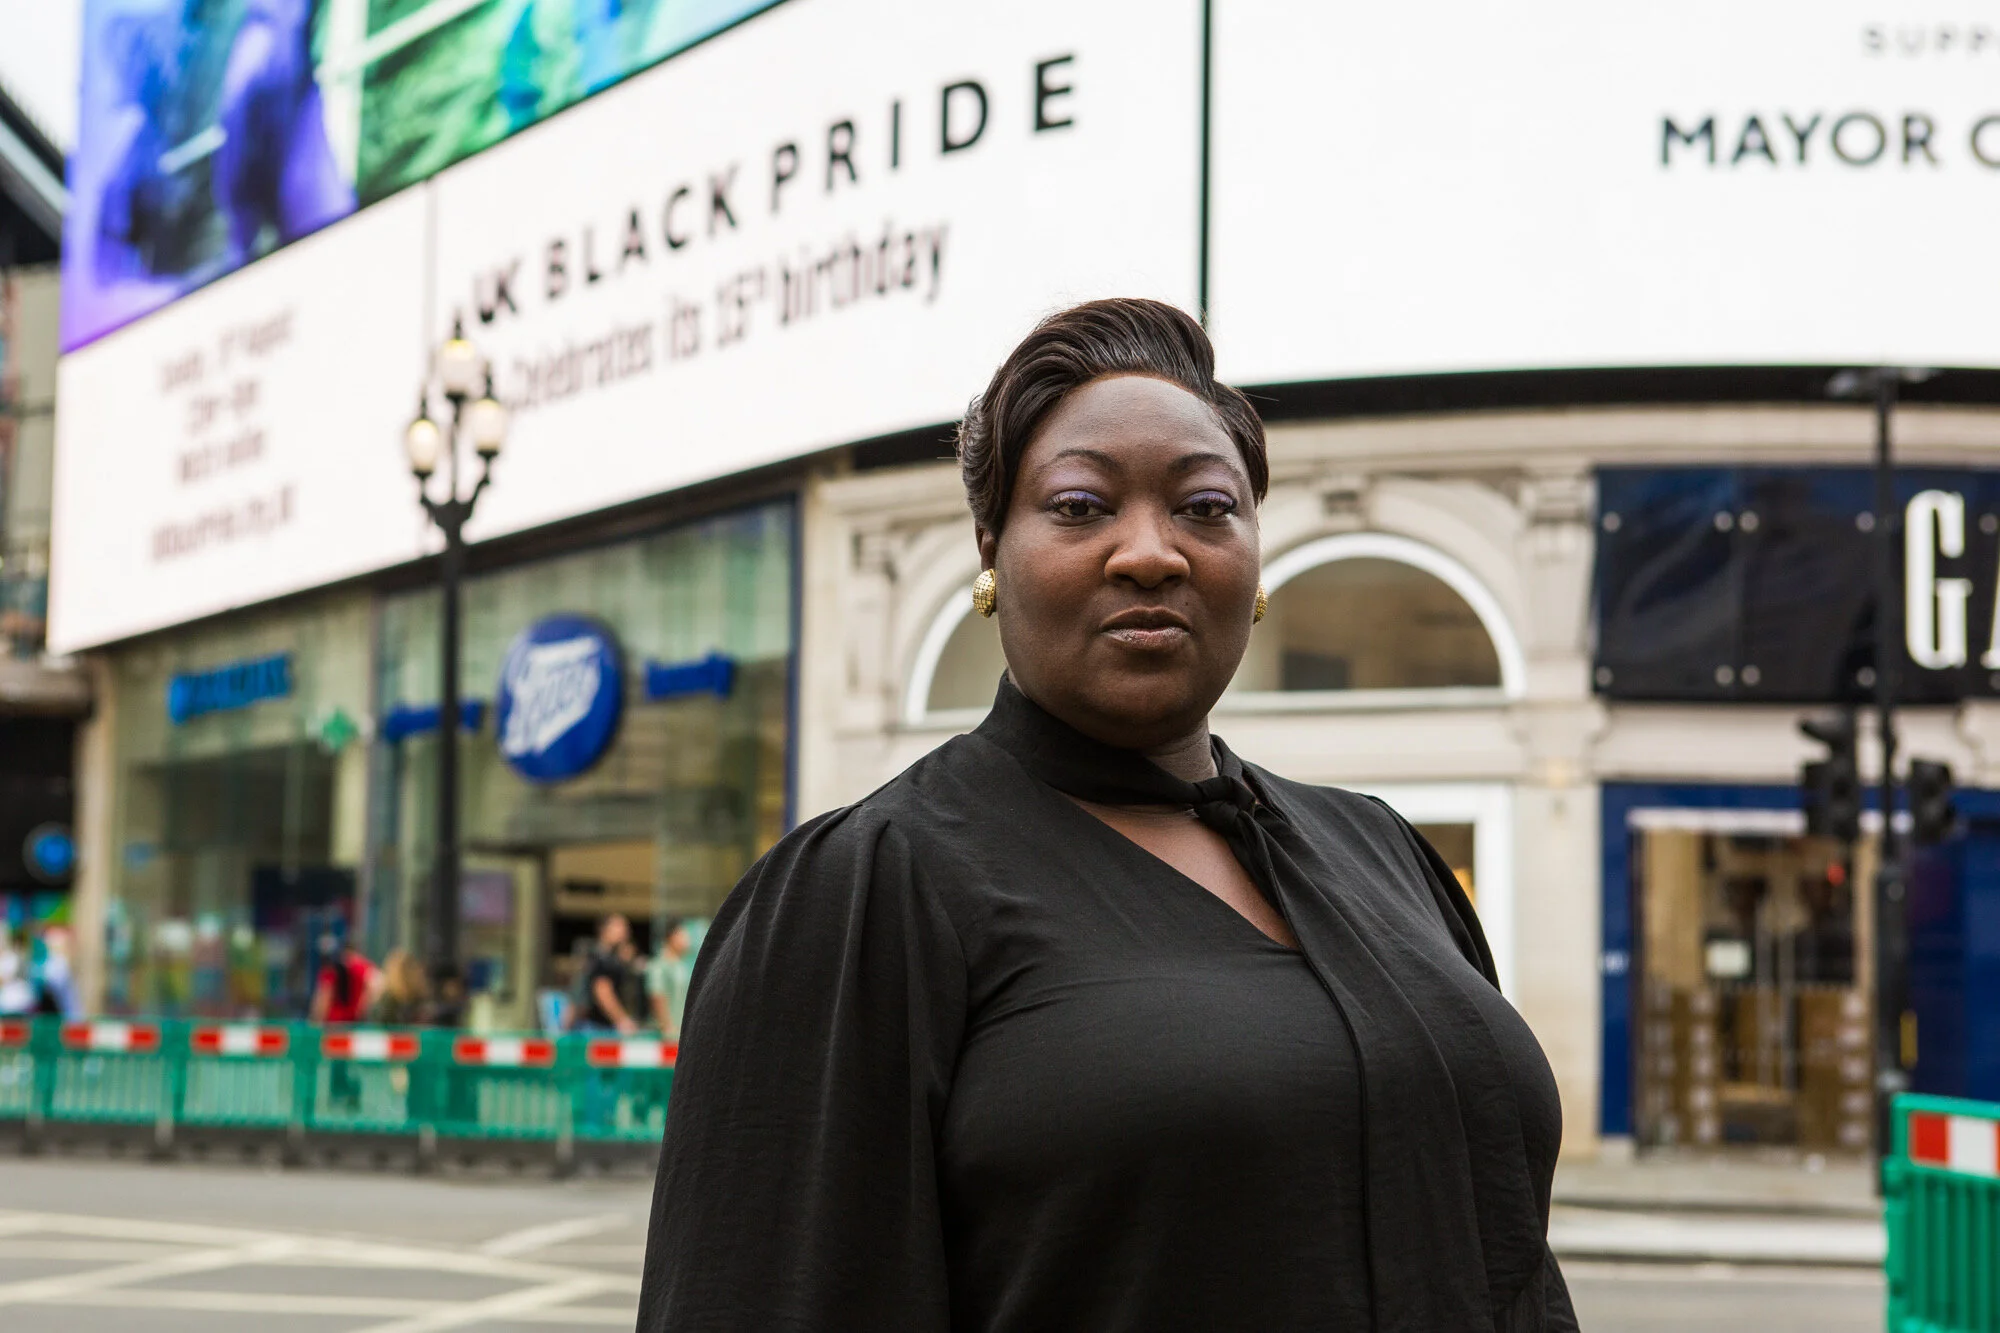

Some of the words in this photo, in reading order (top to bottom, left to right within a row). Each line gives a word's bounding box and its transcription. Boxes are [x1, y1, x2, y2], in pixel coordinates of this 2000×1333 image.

[473, 255, 520, 324] UK
[542, 162, 738, 300] BLACK
[770, 52, 1077, 212] PRIDE
[1660, 112, 1940, 166] MAYOR
[778, 218, 950, 326] birthday
